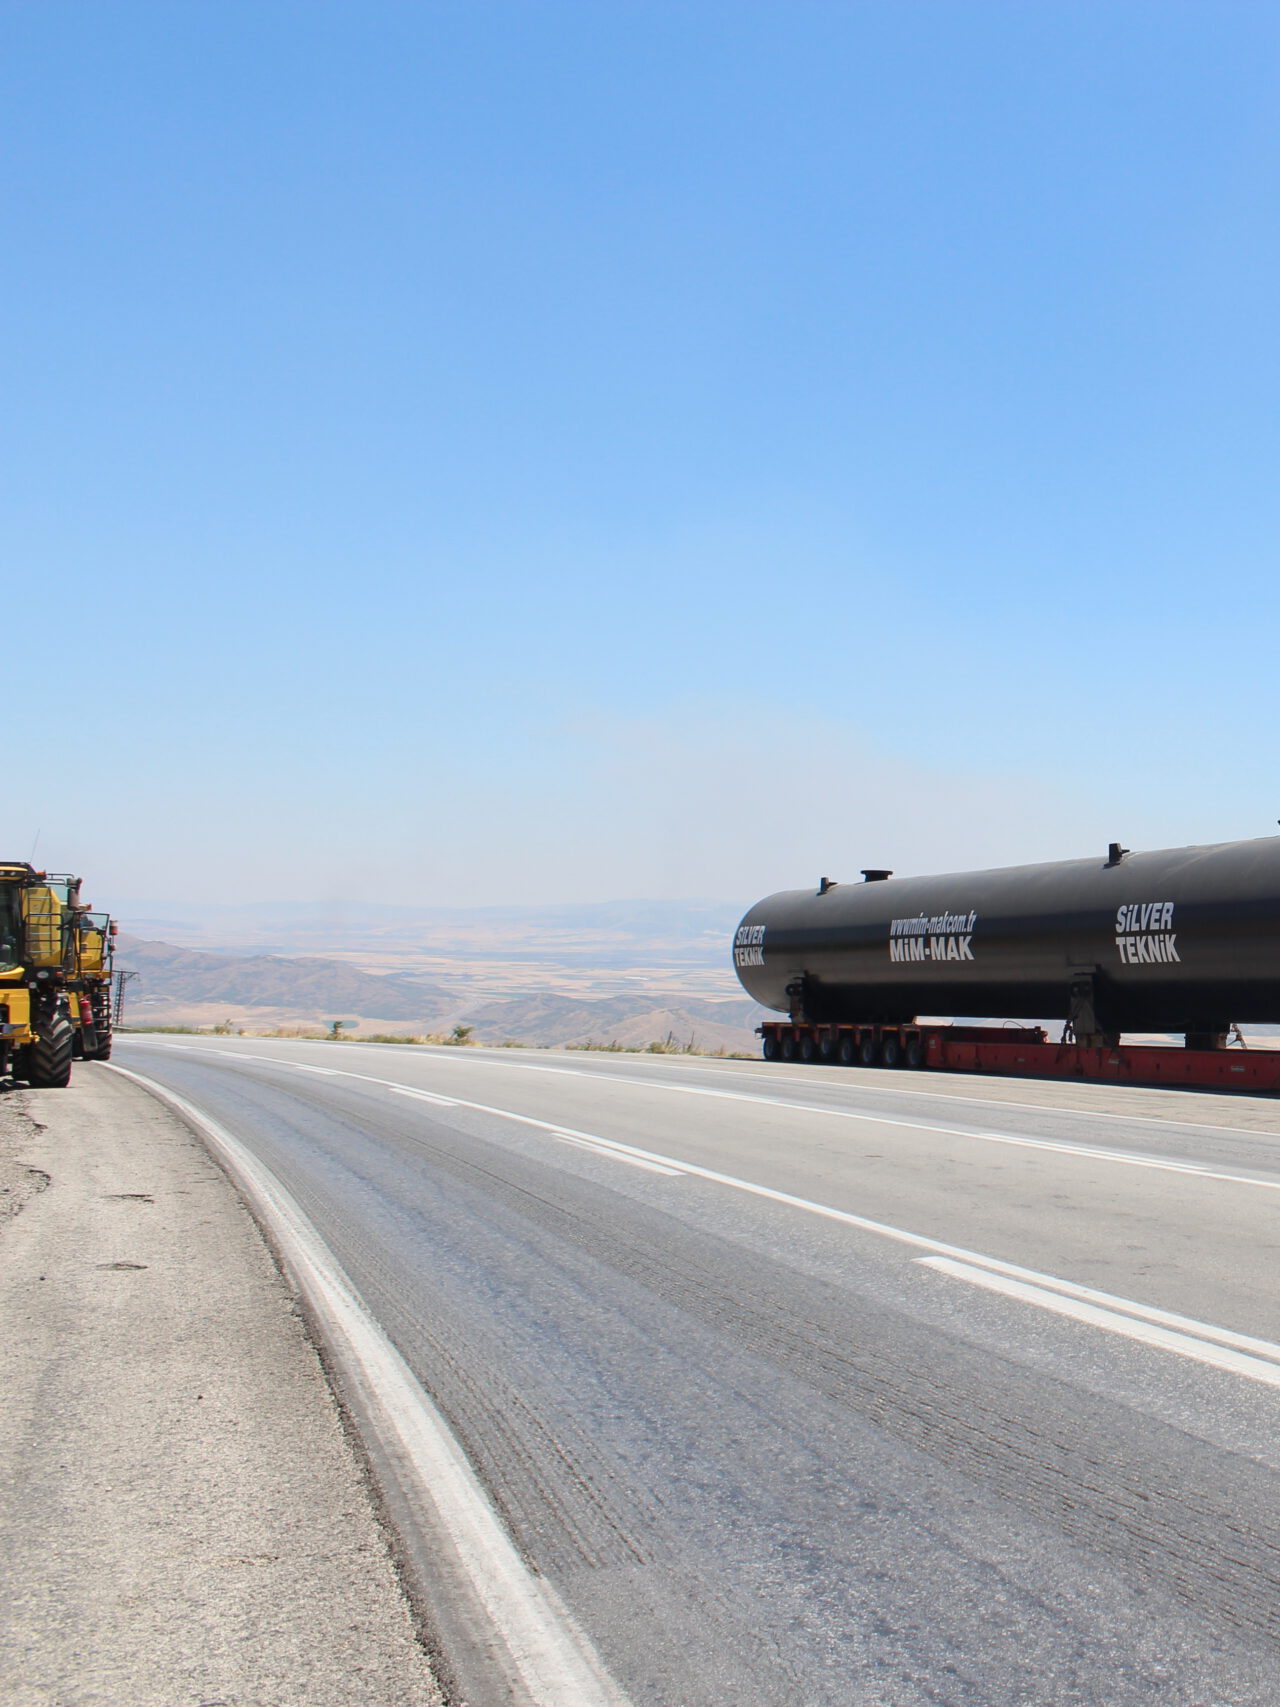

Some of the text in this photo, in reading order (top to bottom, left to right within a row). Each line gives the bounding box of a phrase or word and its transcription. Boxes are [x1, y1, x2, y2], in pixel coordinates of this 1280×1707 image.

[1115, 902, 1175, 933] SiLVER
[889, 935, 975, 962] MiM-MAK
[1115, 934, 1181, 964] TEKNiK
